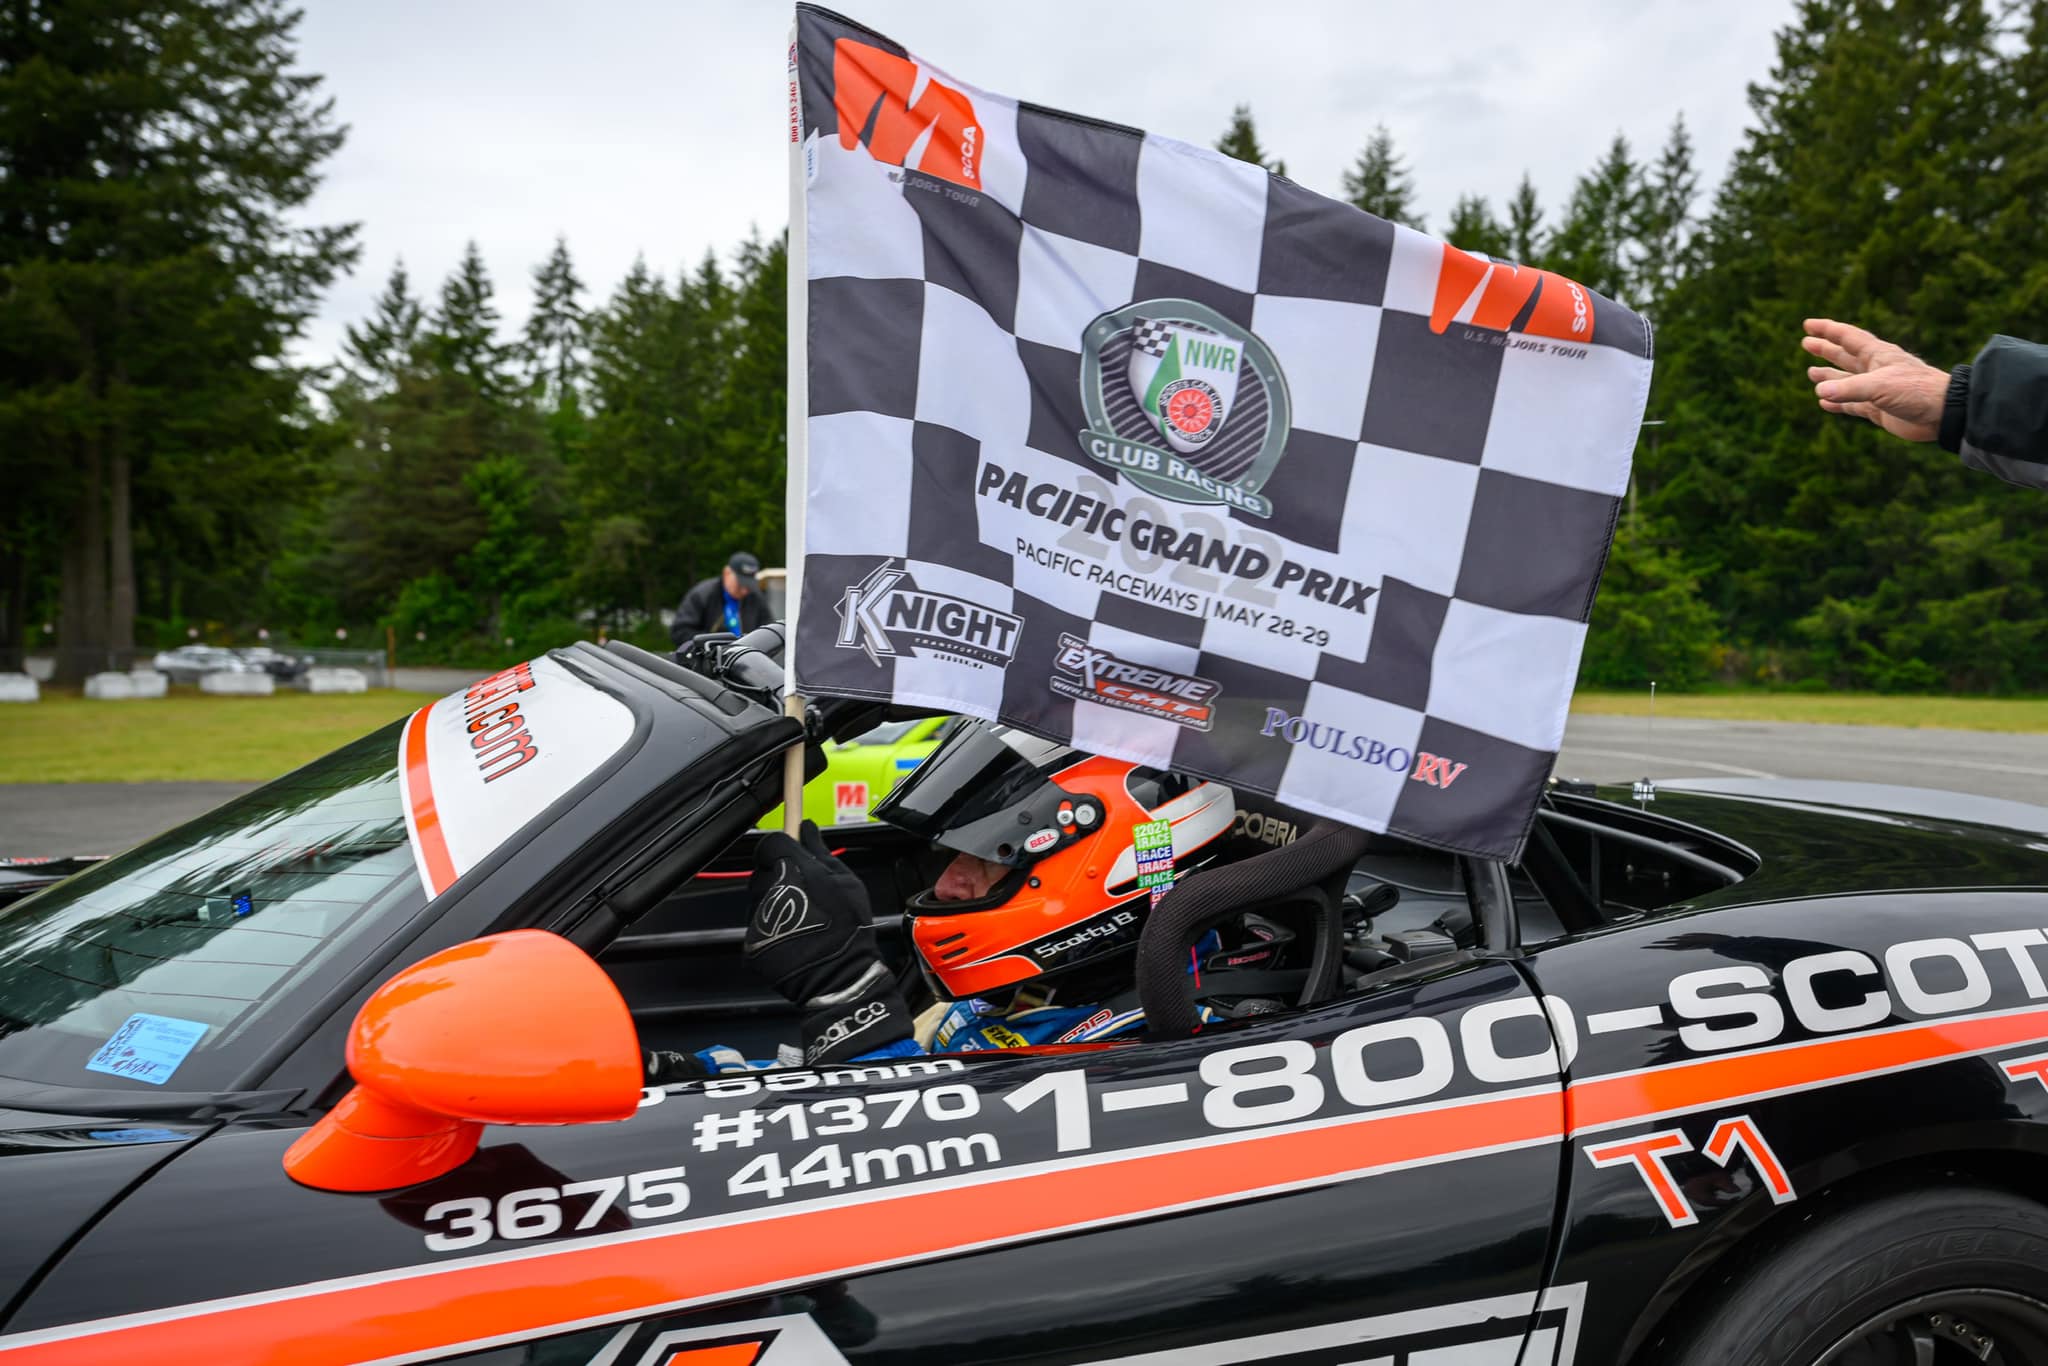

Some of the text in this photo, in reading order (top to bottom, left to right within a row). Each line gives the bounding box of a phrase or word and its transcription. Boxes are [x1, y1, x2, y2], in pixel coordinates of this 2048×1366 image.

[961, 125, 978, 180] SCCA
[944, 187, 981, 208] TOUR
[1183, 338, 1237, 374] NWR
[1490, 335, 1548, 354] MAJORS
[1550, 345, 1589, 361] TOUR
[1090, 438, 1263, 512] CLUB RACING
[977, 462, 1381, 615] PACIFIC GRAND PRIX
[1056, 474, 1286, 608] 2022
[835, 566, 1018, 656] KNIGHT
[1016, 537, 1083, 578] PACIFIC
[1086, 564, 1199, 612] RACEWAYS
[1213, 603, 1264, 632] MAY
[1267, 615, 1331, 648] 28-29
[1058, 647, 1213, 701] EXTREME
[1101, 685, 1202, 713] CMT
[1260, 706, 1468, 790] POULSBO RV
[1029, 832, 1056, 849] BELL
[1140, 832, 1171, 849] RACE
[1142, 846, 1172, 861] RACE
[1231, 809, 1299, 848] COBRA
[1144, 859, 1175, 874] RACE
[1145, 871, 1175, 887] RACE
[1034, 922, 1118, 959] Scotty
[807, 1001, 888, 1067] sparco
[1003, 928, 2048, 1153] 1-800-SCOT
[692, 1084, 981, 1152] #1370
[423, 1129, 1001, 1252] 3675 44mm
[1582, 1115, 1797, 1229] T1
